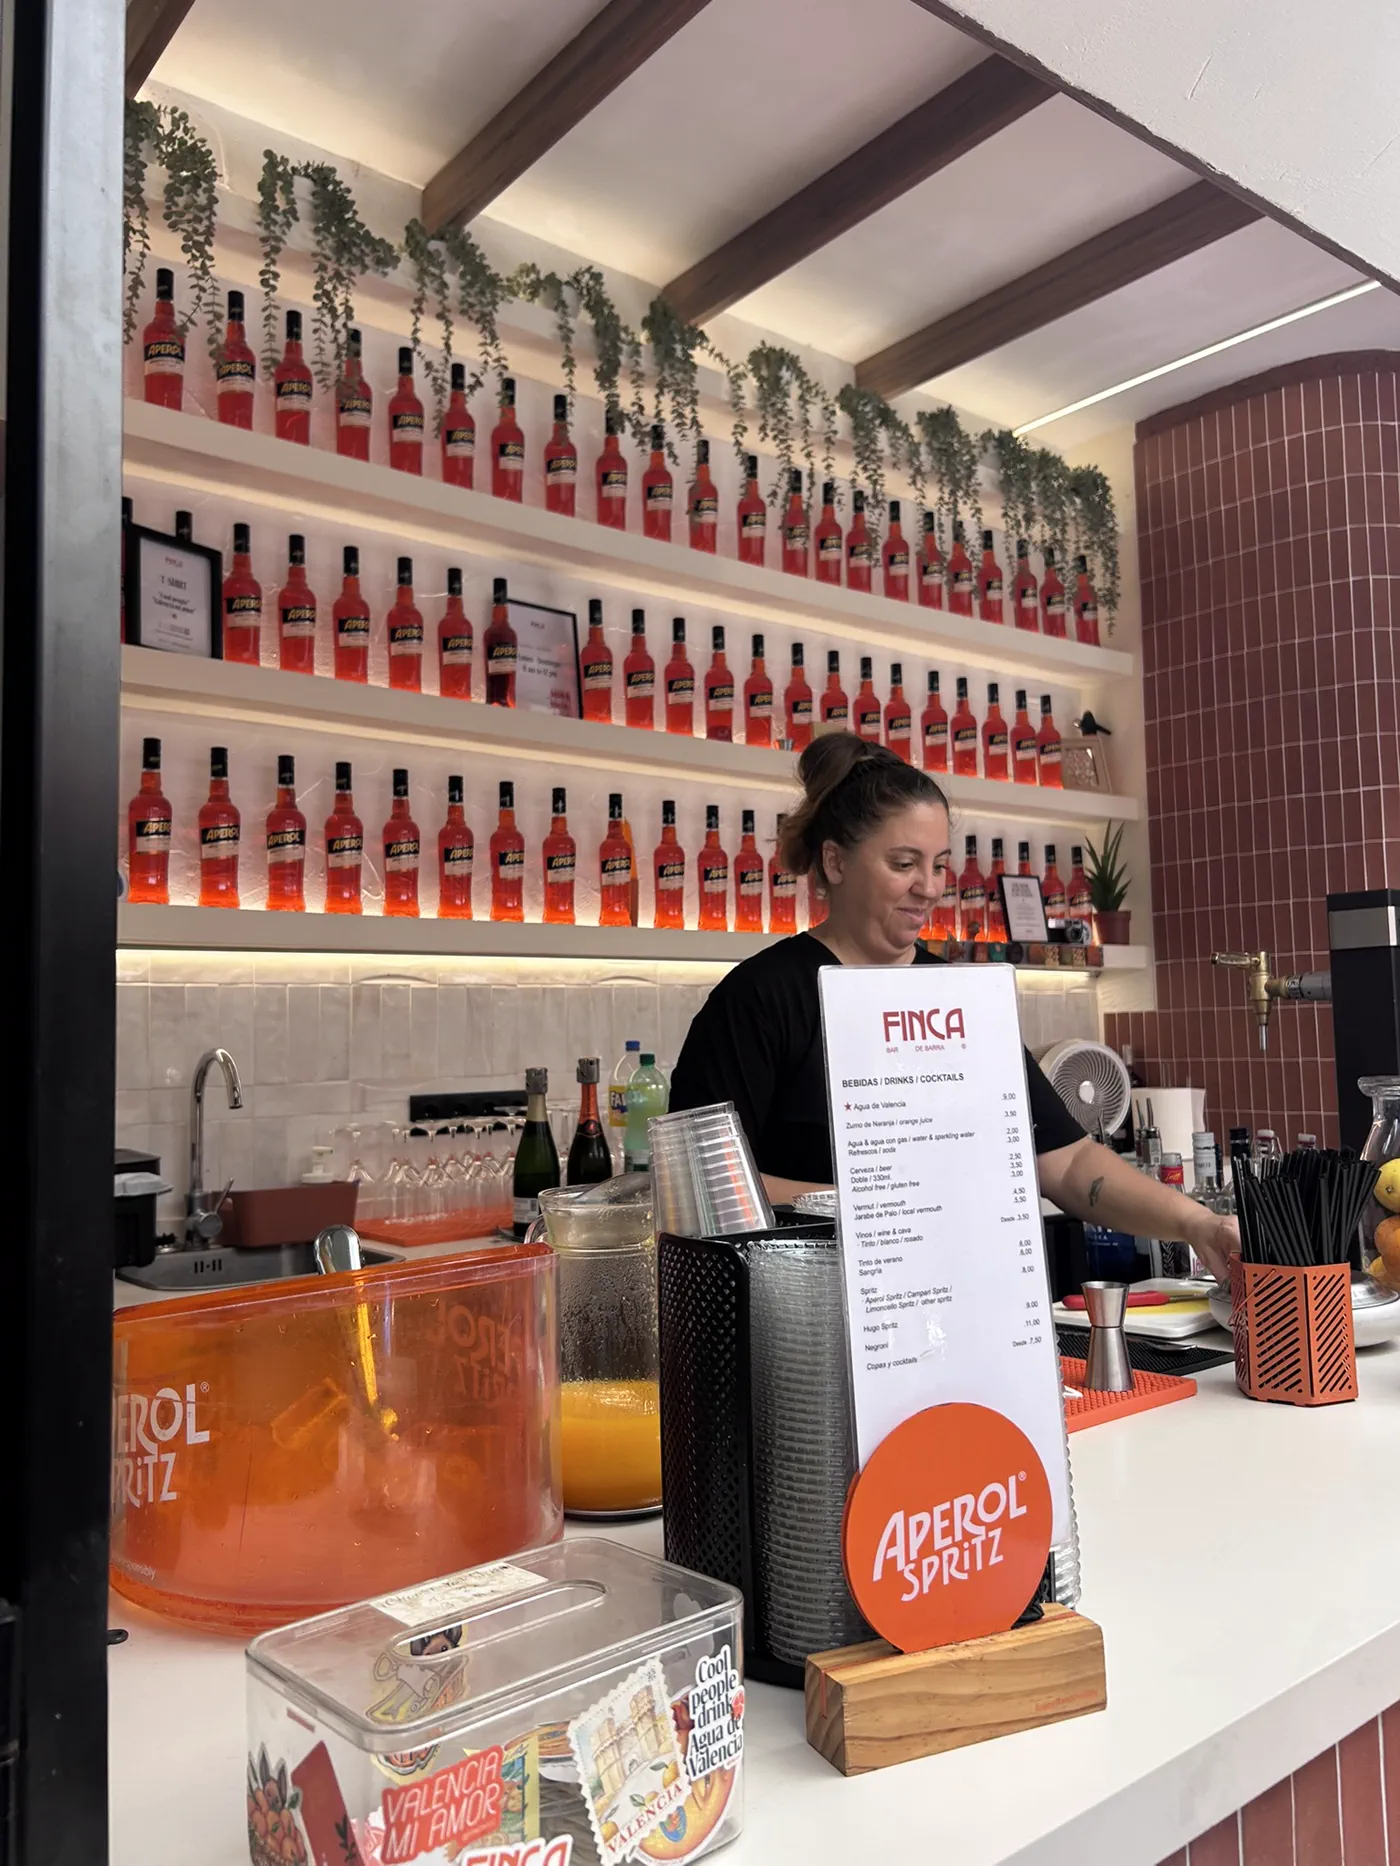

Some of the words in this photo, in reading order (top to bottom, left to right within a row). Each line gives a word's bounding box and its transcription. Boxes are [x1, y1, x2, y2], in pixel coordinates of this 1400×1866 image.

[399, 414, 424, 428] APERO
[232, 598, 262, 611] APER
[288, 609, 316, 622] APER
[345, 619, 369, 632] APER
[395, 629, 423, 642] APERO
[143, 822, 171, 835] APER
[268, 829, 303, 846] APEROL
[449, 849, 473, 861] APER
[883, 1008, 965, 1042] FINCA
[842, 1079, 878, 1088] BEBIDAS
[885, 1076, 914, 1085] DRINKS
[920, 1073, 964, 1083] COCKTAILS
[854, 1103, 870, 1112] Agua
[880, 1100, 906, 1108] Valencia
[873, 1119, 894, 1127] Naranja
[919, 1117, 933, 1125] juice
[848, 1140, 863, 1148] Agua
[870, 1139, 884, 1147] agua
[935, 1132, 958, 1141] sparkling
[848, 1148, 877, 1156] Refrescos
[851, 1176, 868, 1184] Doble
[852, 1185, 873, 1193] Alcohol
[891, 1182, 907, 1190] gluten
[853, 1203, 874, 1211] Vermut
[880, 1200, 906, 1209] vermouth
[854, 1212, 874, 1220] Jarabe
[916, 1205, 942, 1213] vermouth
[855, 1231, 872, 1239] Vinos
[861, 1240, 875, 1248] Tinto
[880, 1238, 899, 1246] blanco
[859, 1259, 873, 1267] Tinto
[883, 1256, 903, 1264] verano
[860, 1287, 877, 1295] Spritz
[865, 1296, 884, 1304] Aperol
[886, 1293, 902, 1302] Spritz
[907, 1289, 931, 1298] Campari
[932, 1287, 948, 1295] Spritz
[866, 1303, 897, 1313] Limoncello
[899, 1301, 914, 1309] Spritz
[937, 1296, 952, 1304] spritz
[863, 1325, 879, 1333] Hugo
[881, 1322, 898, 1330] Spritz
[865, 1342, 888, 1352] Negroni
[867, 1362, 886, 1371] Copas
[892, 1356, 917, 1366] cocktails
[698, 1649, 727, 1683] Cool
[692, 1672, 736, 1715] people
[697, 1692, 733, 1728] drink
[690, 1724, 723, 1756] Agua
[727, 1716, 741, 1735] de
[689, 1734, 742, 1777] Valencia
[388, 1751, 499, 1823] VALENCIA
[386, 1820, 419, 1860] MI
[428, 1783, 500, 1847] AMOR
[608, 1783, 682, 1853] VALENCIA
